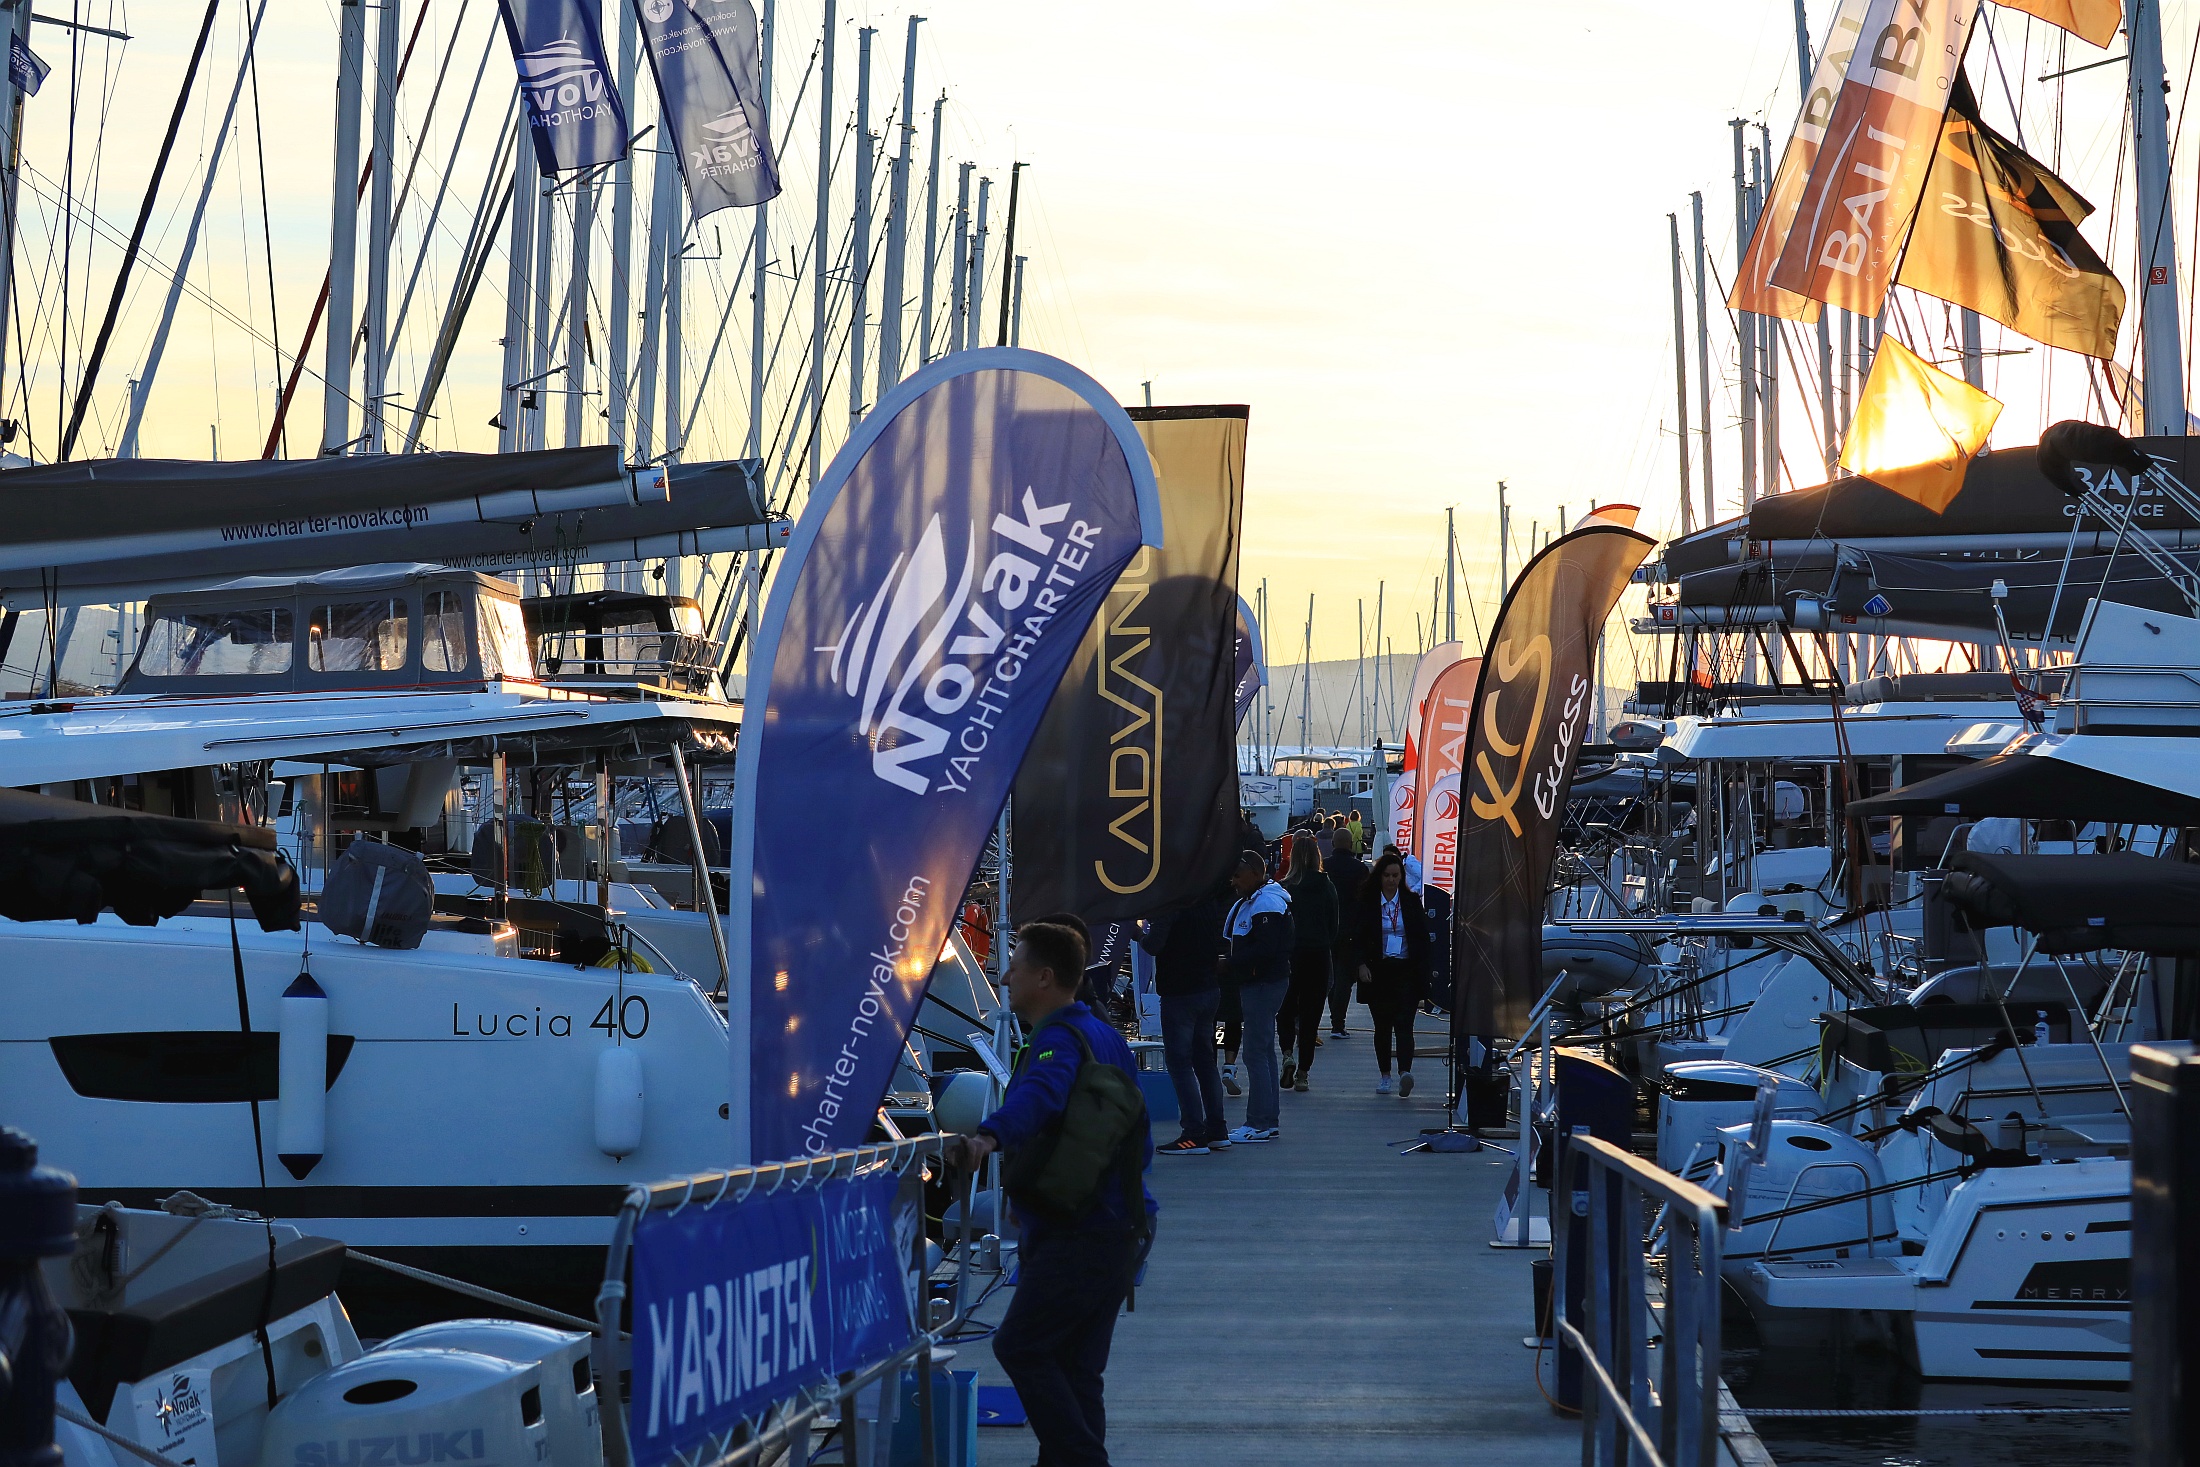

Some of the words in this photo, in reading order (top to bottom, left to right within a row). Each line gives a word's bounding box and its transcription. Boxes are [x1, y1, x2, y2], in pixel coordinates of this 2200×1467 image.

[1819, 125, 1907, 277] BALI
[221, 505, 429, 542] www.charter-novak.com
[442, 545, 589, 569] www.charter-novak.com
[873, 486, 1072, 796] Novak
[936, 519, 1103, 793] YACHTCHARTER
[1435, 696, 1470, 783] BALI
[1534, 673, 1588, 820] Excess
[453, 1003, 571, 1037] Lucia
[589, 995, 650, 1040] 40
[2024, 1287, 2128, 1300] MERRY
[647, 1255, 817, 1438] MARINETEK
[171, 1390, 201, 1417] Novak
[294, 1428, 485, 1467] SUZUKI
